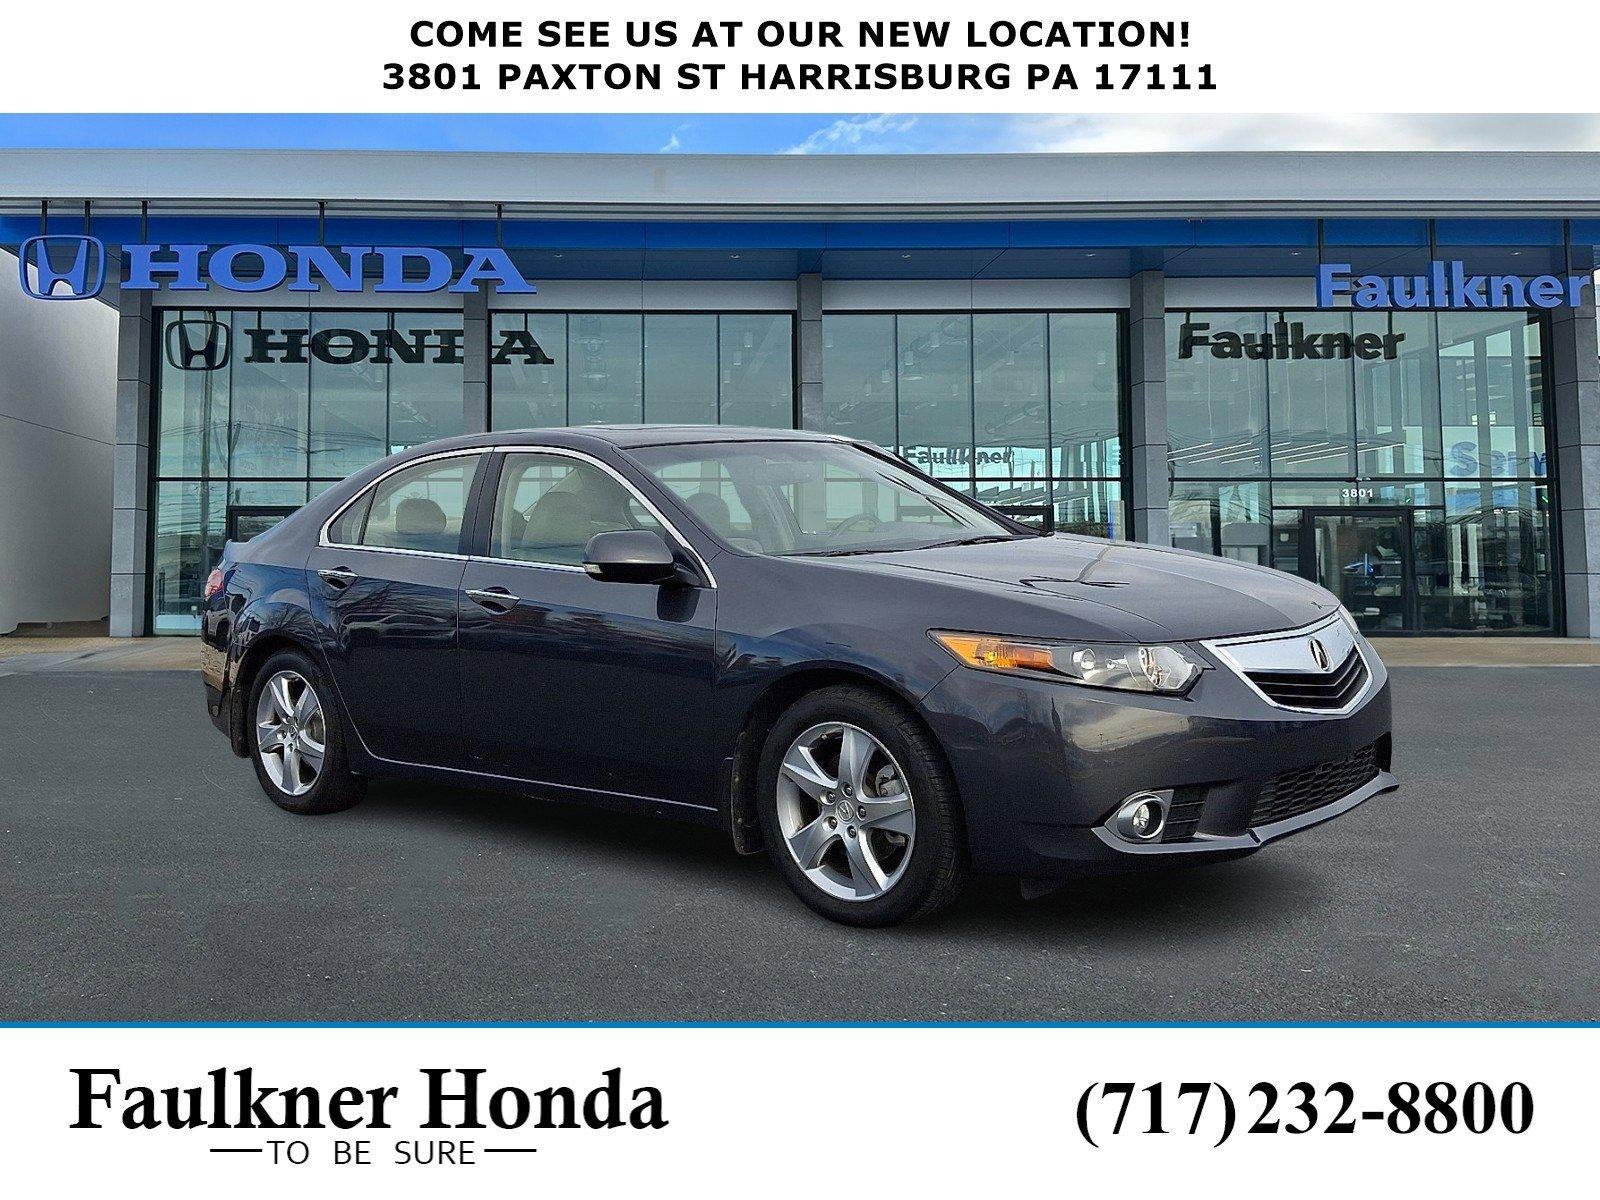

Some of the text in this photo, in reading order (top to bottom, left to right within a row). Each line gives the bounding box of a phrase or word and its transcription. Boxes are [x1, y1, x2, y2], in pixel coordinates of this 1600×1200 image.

[121, 244, 537, 295] HONDA
[1316, 260, 1591, 309] Faulkner
[1178, 321, 1405, 360] Faulkner
[1342, 488, 1373, 498] 3801
